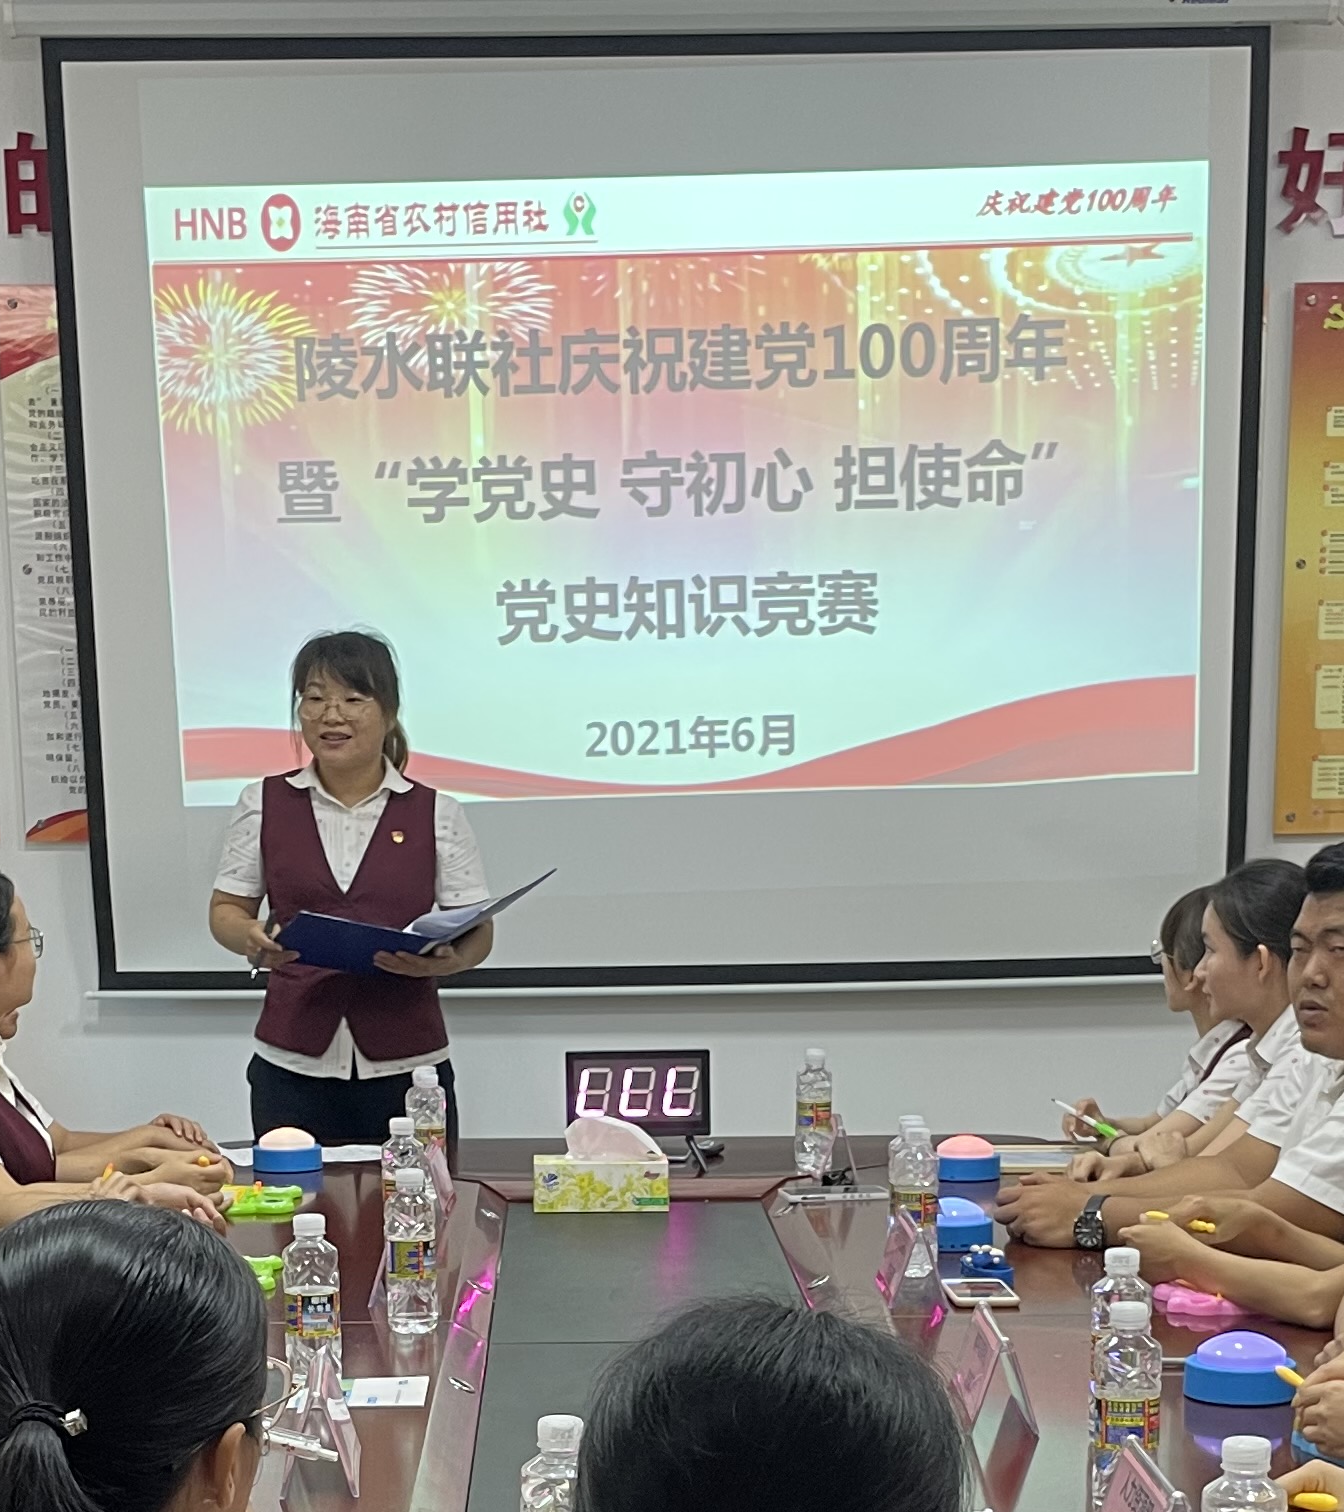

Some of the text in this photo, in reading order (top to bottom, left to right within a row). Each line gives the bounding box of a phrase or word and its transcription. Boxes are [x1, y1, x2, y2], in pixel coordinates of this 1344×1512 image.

[174, 206, 248, 241] HNB
[313, 200, 551, 239] 海南省农村信用社
[976, 183, 1178, 218] 庆祝建党100周年
[294, 313, 1069, 402] 陵水联社庆祝建党100周年
[620, 445, 814, 518] 守初心
[496, 569, 879, 646] 党史知识竞赛
[584, 713, 796, 759] 2021年6月
